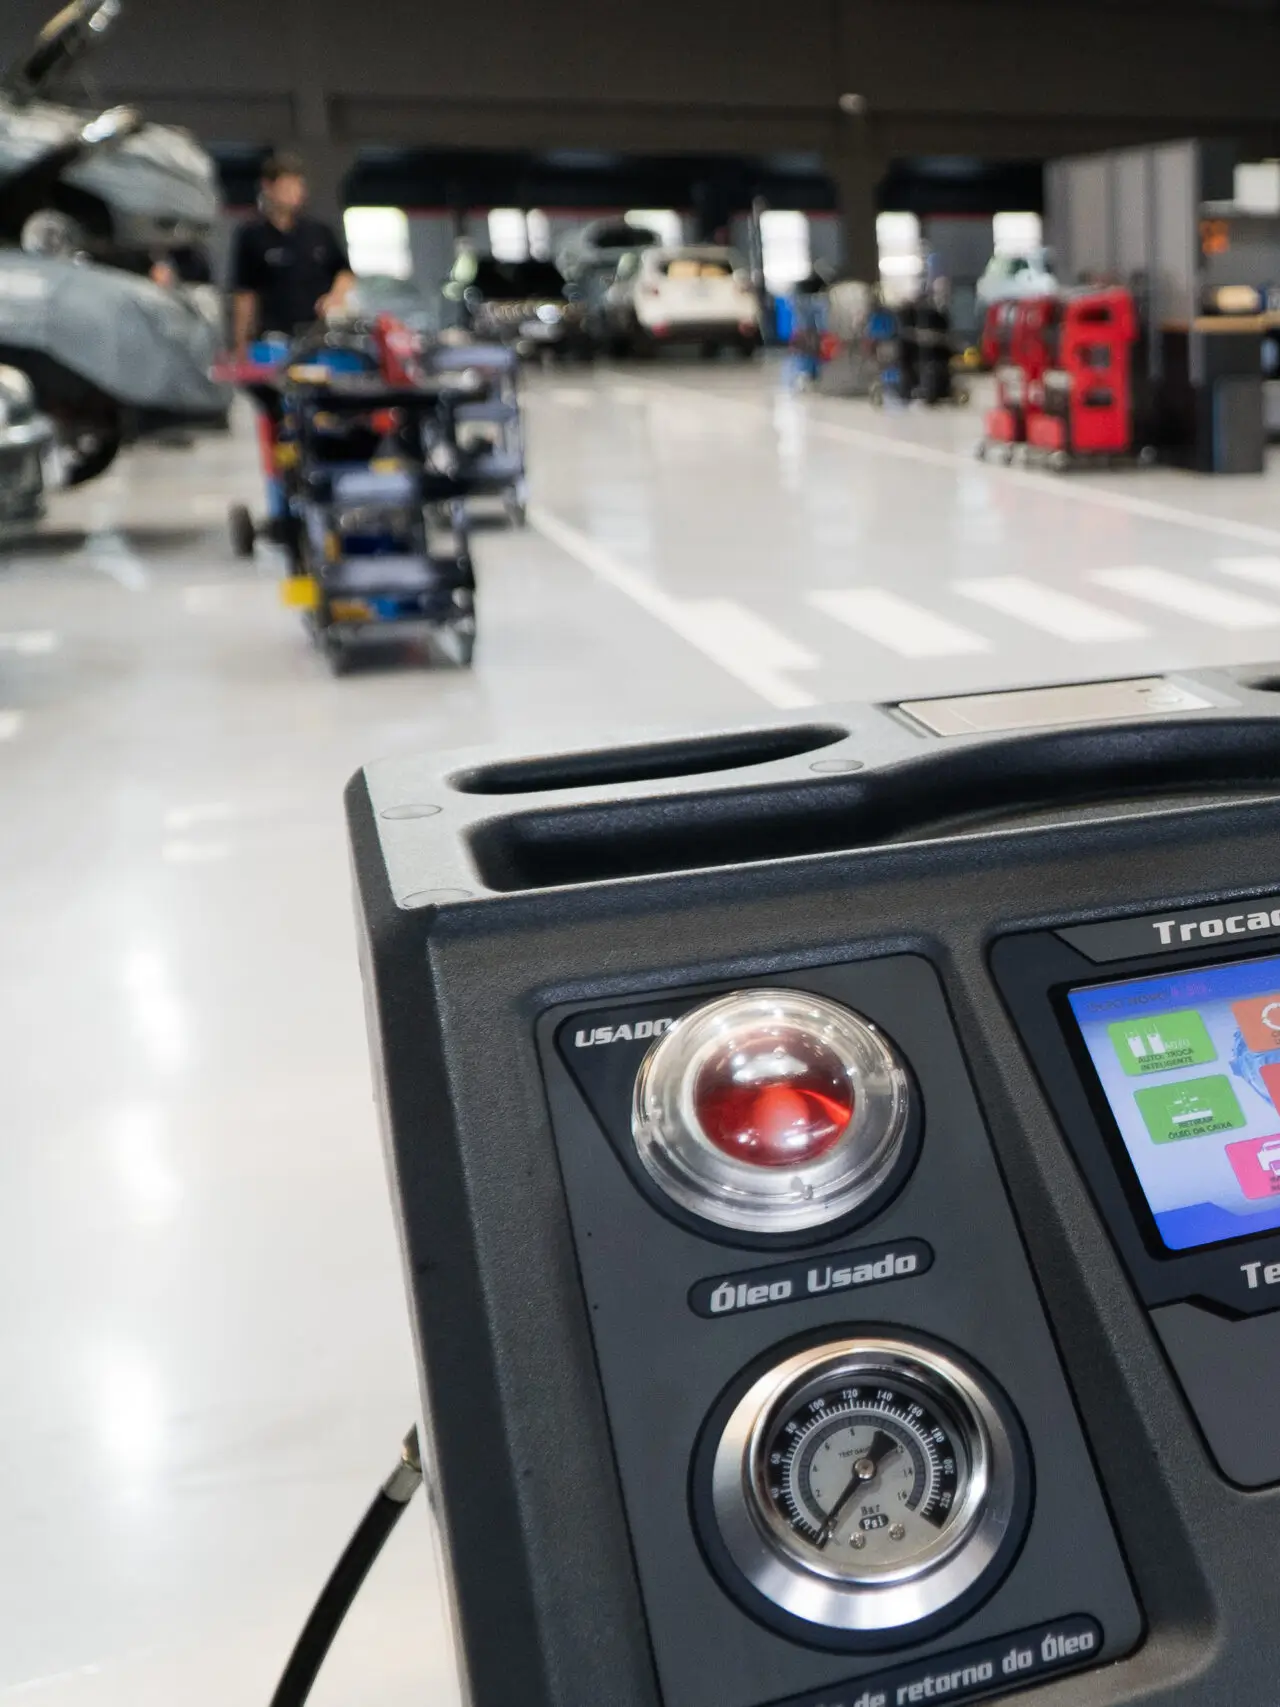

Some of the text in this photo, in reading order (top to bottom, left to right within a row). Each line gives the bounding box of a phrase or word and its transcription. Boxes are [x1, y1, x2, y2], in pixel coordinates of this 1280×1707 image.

[575, 1018, 674, 1048] USADO
[1206, 1121, 1233, 1133] CAIXA
[710, 1253, 917, 1313] Óleo Usado
[842, 1388, 858, 1399] 120
[876, 1390, 893, 1402] 140
[808, 1399, 825, 1413] 100
[908, 1403, 923, 1417] 160
[931, 1427, 945, 1443] 180
[860, 1504, 881, 1517] Bar
[897, 1661, 993, 1705] retorno
[1002, 1648, 1032, 1675] do
[1041, 1632, 1095, 1662] Óleo
